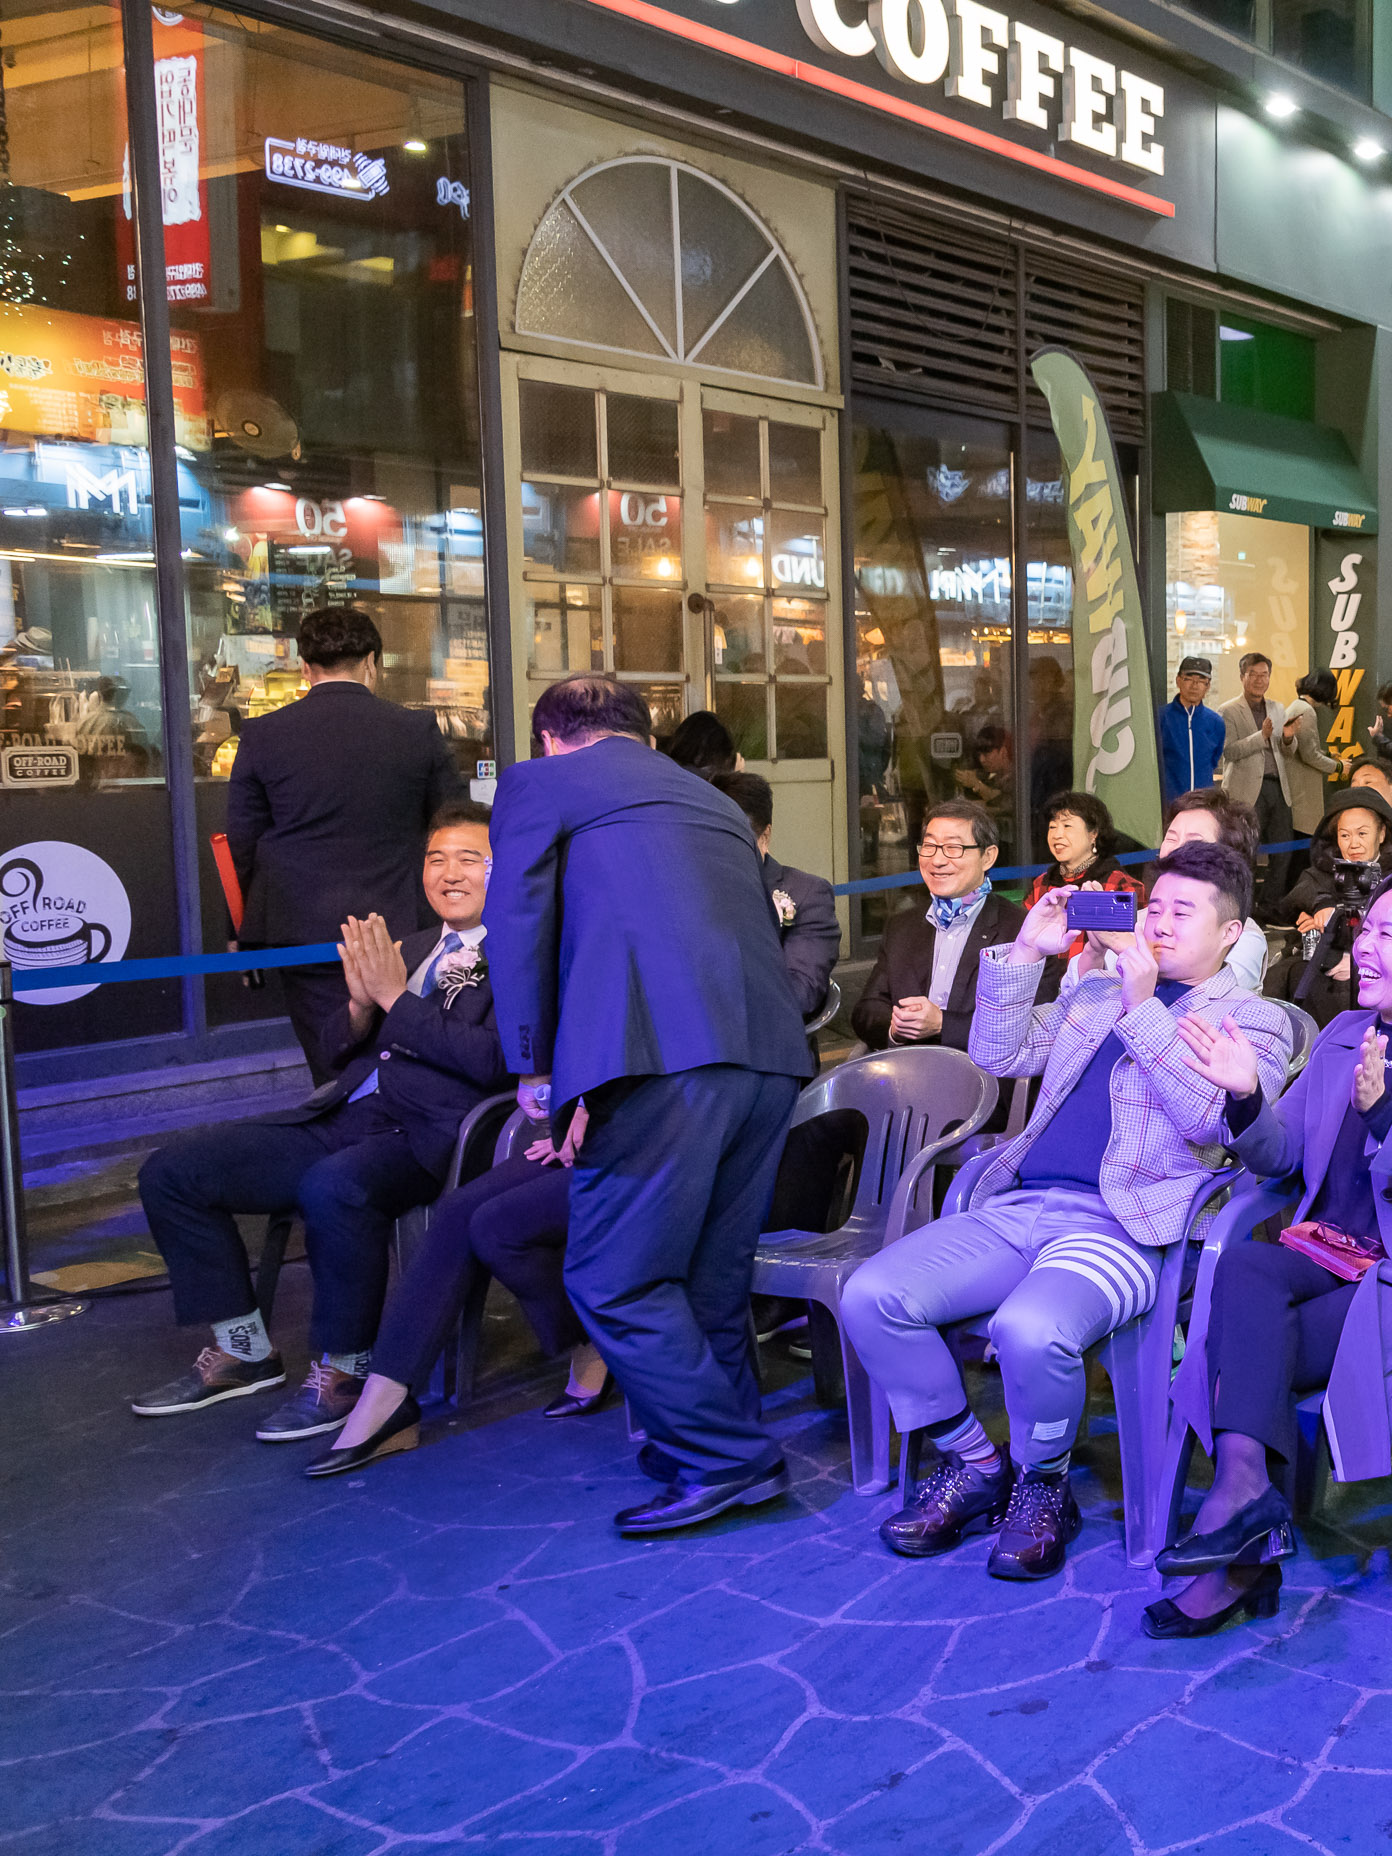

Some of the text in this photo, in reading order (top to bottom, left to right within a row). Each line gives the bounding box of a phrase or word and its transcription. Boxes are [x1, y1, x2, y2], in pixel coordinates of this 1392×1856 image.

[800, 0, 1165, 176] COFFEE
[13, 756, 67, 767] OFF-ROAD
[16, 768, 66, 776] COFFEE
[0, 896, 87, 925] OFF ROAD
[21, 917, 70, 932] COFFEE
